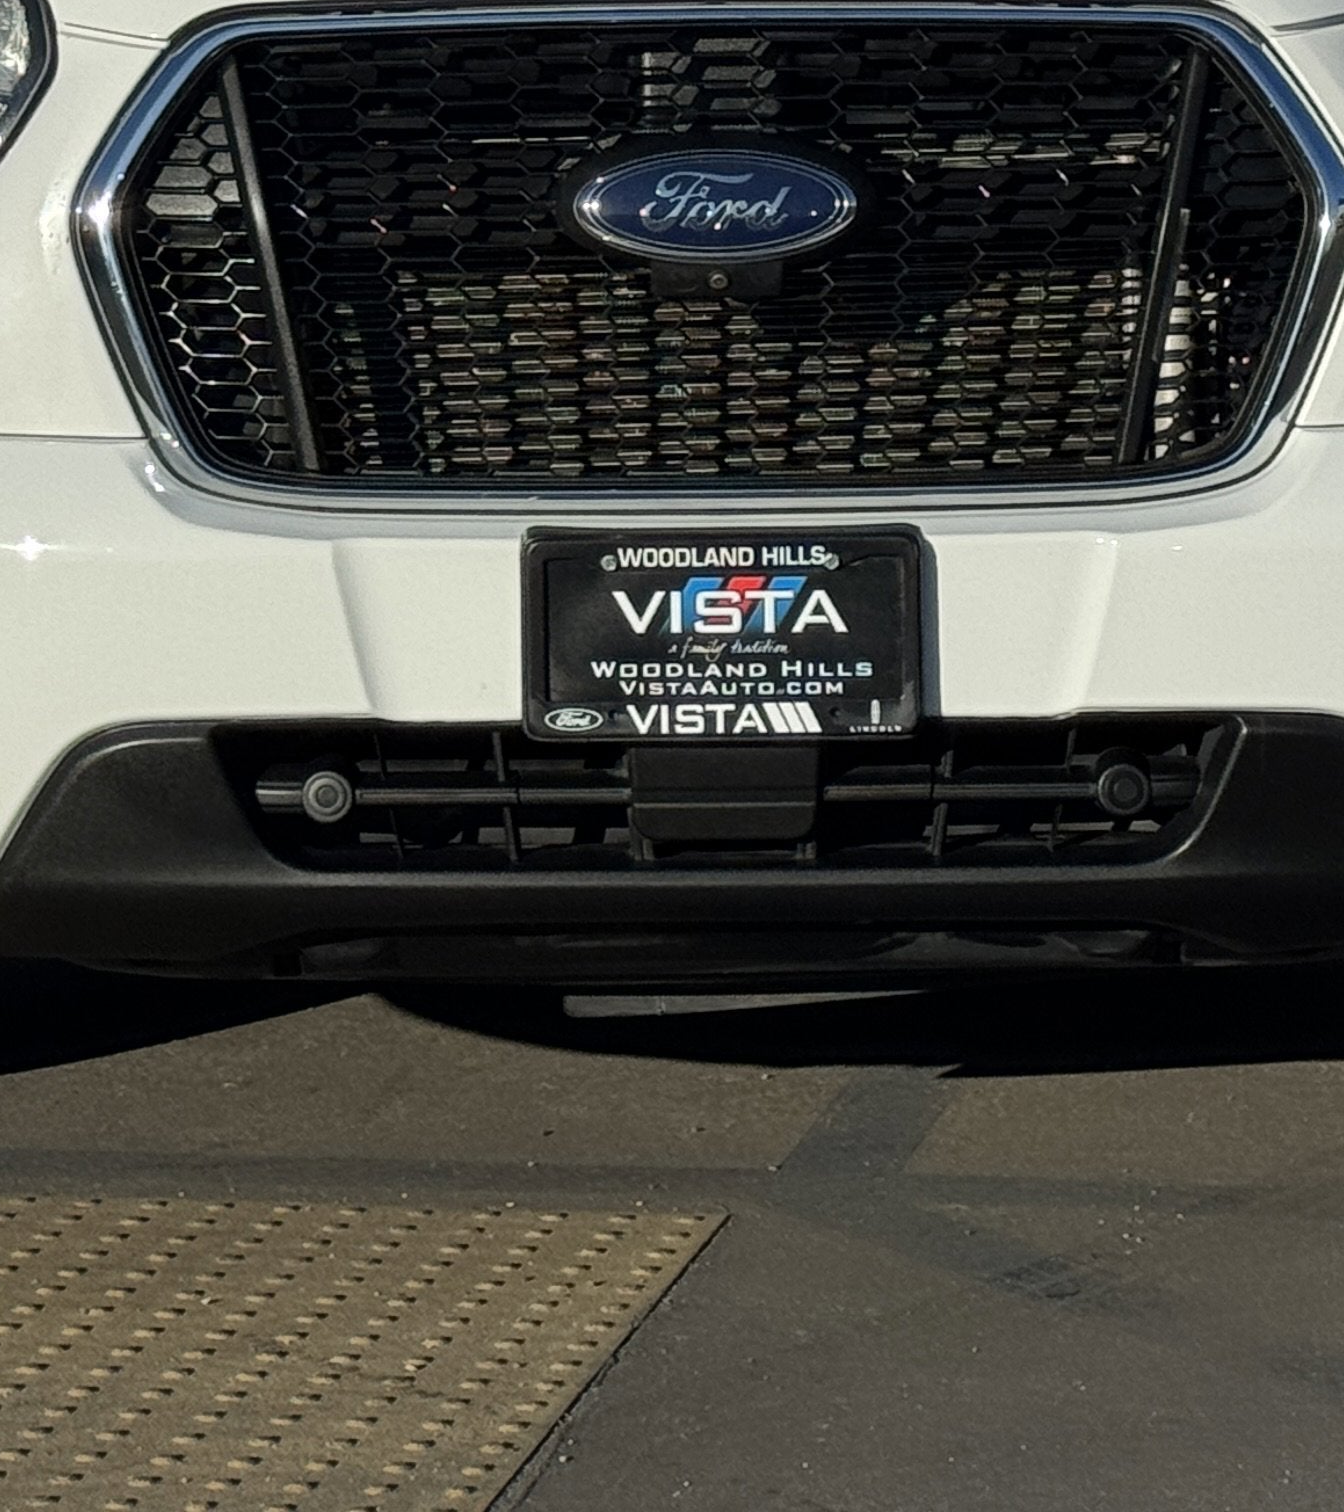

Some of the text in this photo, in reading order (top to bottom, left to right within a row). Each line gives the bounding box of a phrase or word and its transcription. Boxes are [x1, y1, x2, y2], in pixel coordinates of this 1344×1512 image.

[640, 172, 792, 231] Ford
[617, 545, 826, 568] WOODLAND HILLS
[612, 589, 849, 634] VISTA
[556, 712, 591, 726] Ford
[625, 703, 767, 734] VISTA
